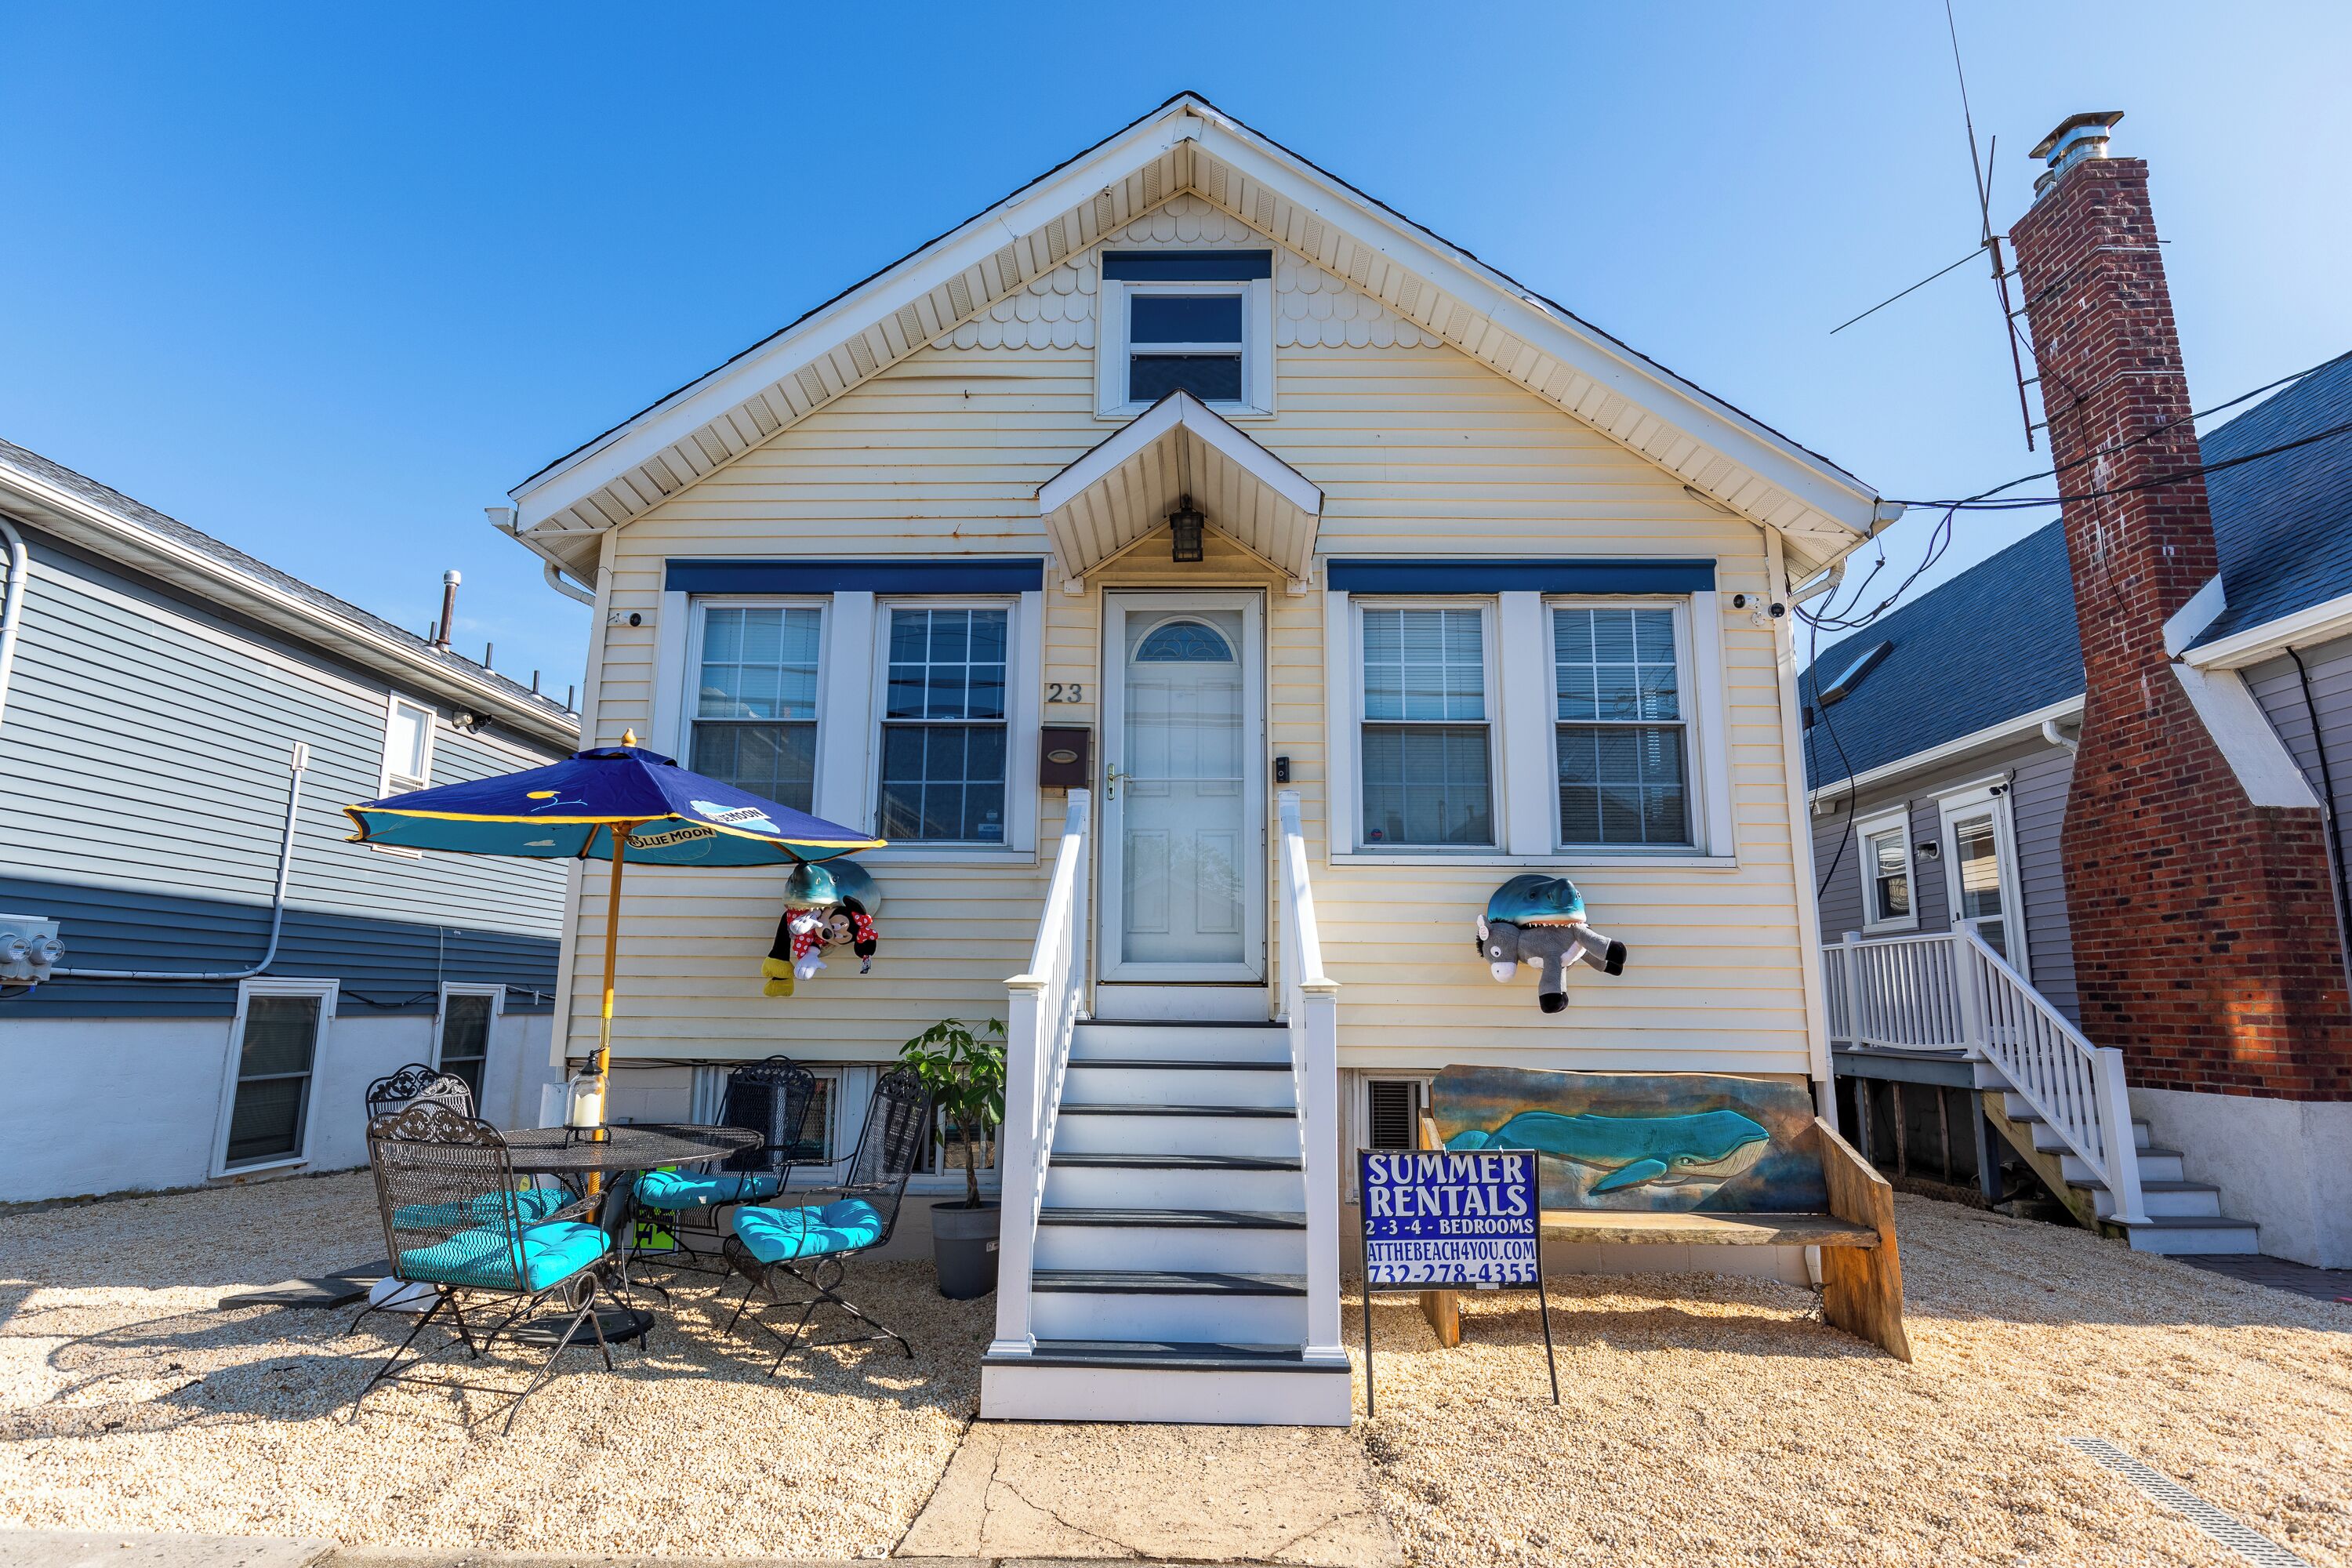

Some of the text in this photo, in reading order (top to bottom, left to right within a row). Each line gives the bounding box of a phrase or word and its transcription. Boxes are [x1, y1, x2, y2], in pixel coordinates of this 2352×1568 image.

[1048, 683, 1082, 702] 23
[725, 810, 764, 822] MOON
[627, 828, 713, 848] BLUE MOON
[1368, 1154, 1525, 1184] SUMMER
[1369, 1185, 1527, 1216] RENTALS
[1439, 1219, 1534, 1235] BEDROOMS
[1367, 1241, 1536, 1261] ATTHEBEACH4YOU.COM
[1368, 1263, 1537, 1283] 732-278-4355
